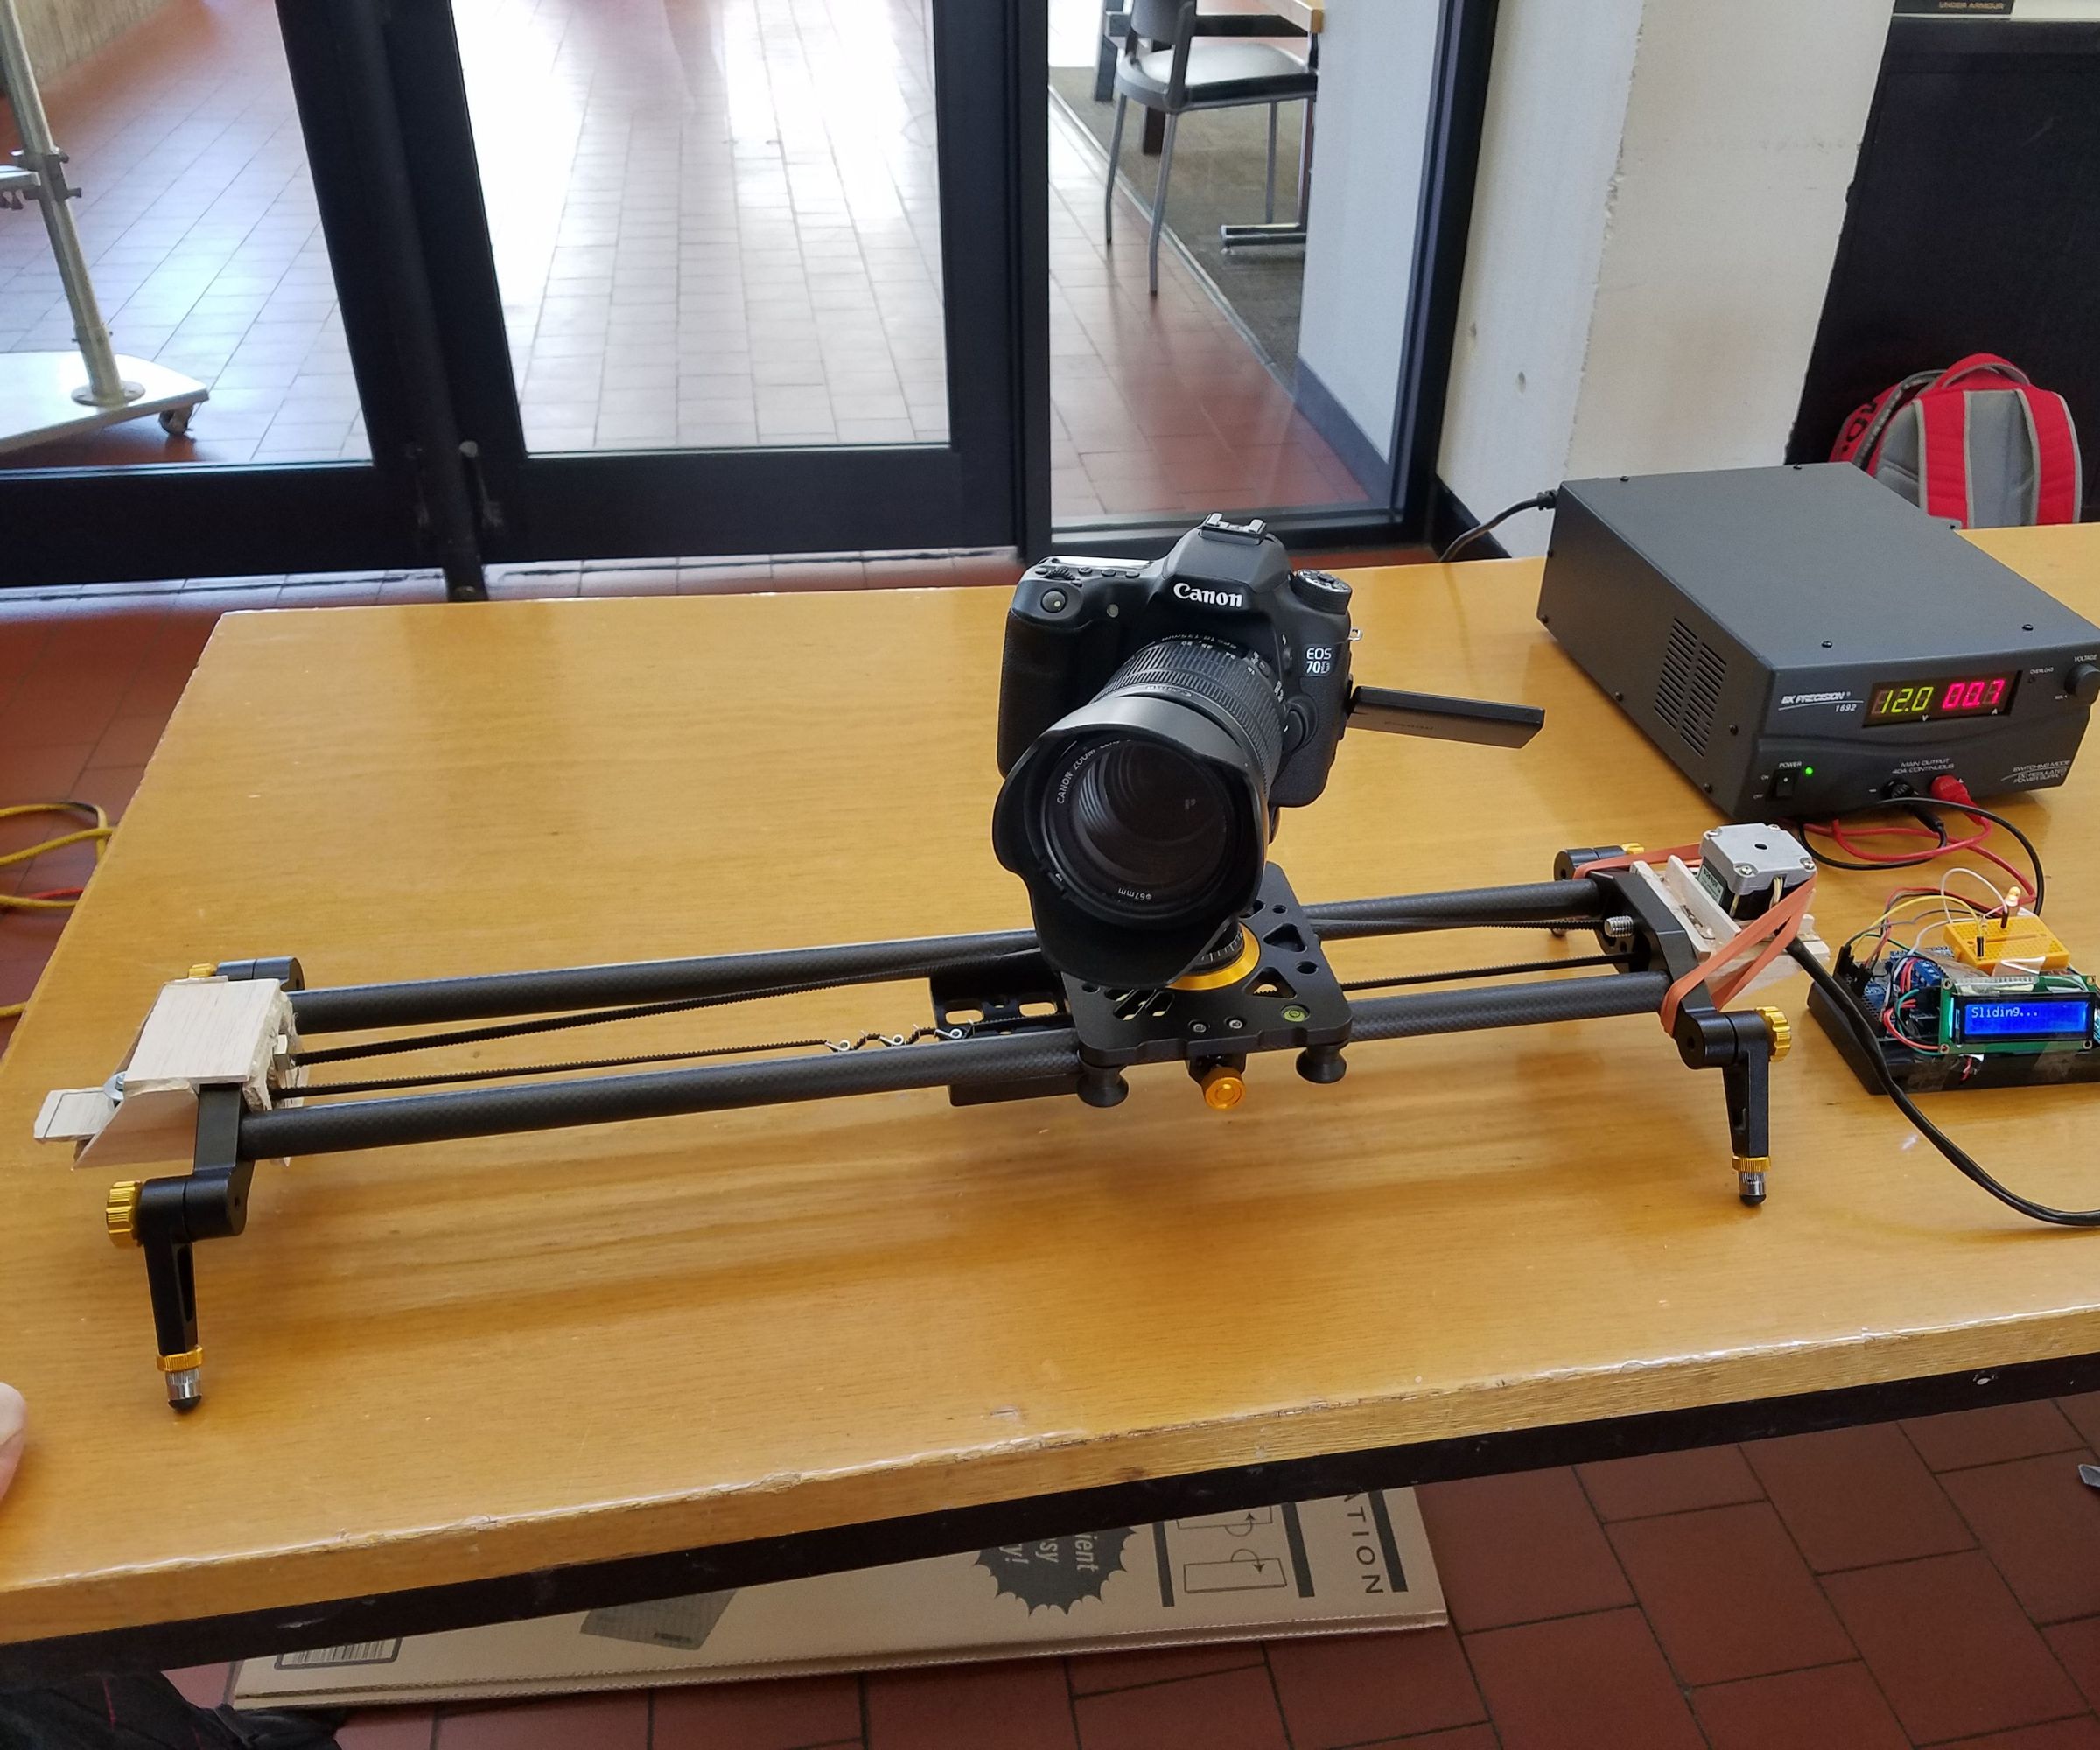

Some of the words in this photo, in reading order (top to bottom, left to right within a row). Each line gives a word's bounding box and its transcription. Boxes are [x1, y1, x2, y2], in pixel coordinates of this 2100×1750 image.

[1173, 583, 1242, 607] Canon
[1306, 648, 1332, 660] EOS
[1306, 661, 1330, 674] 70D
[1835, 704, 1857, 712] 1692
[1057, 771, 1074, 804] CANON
[1971, 1006, 2038, 1018] Sliding...
[1074, 1534, 1099, 1572] ient
